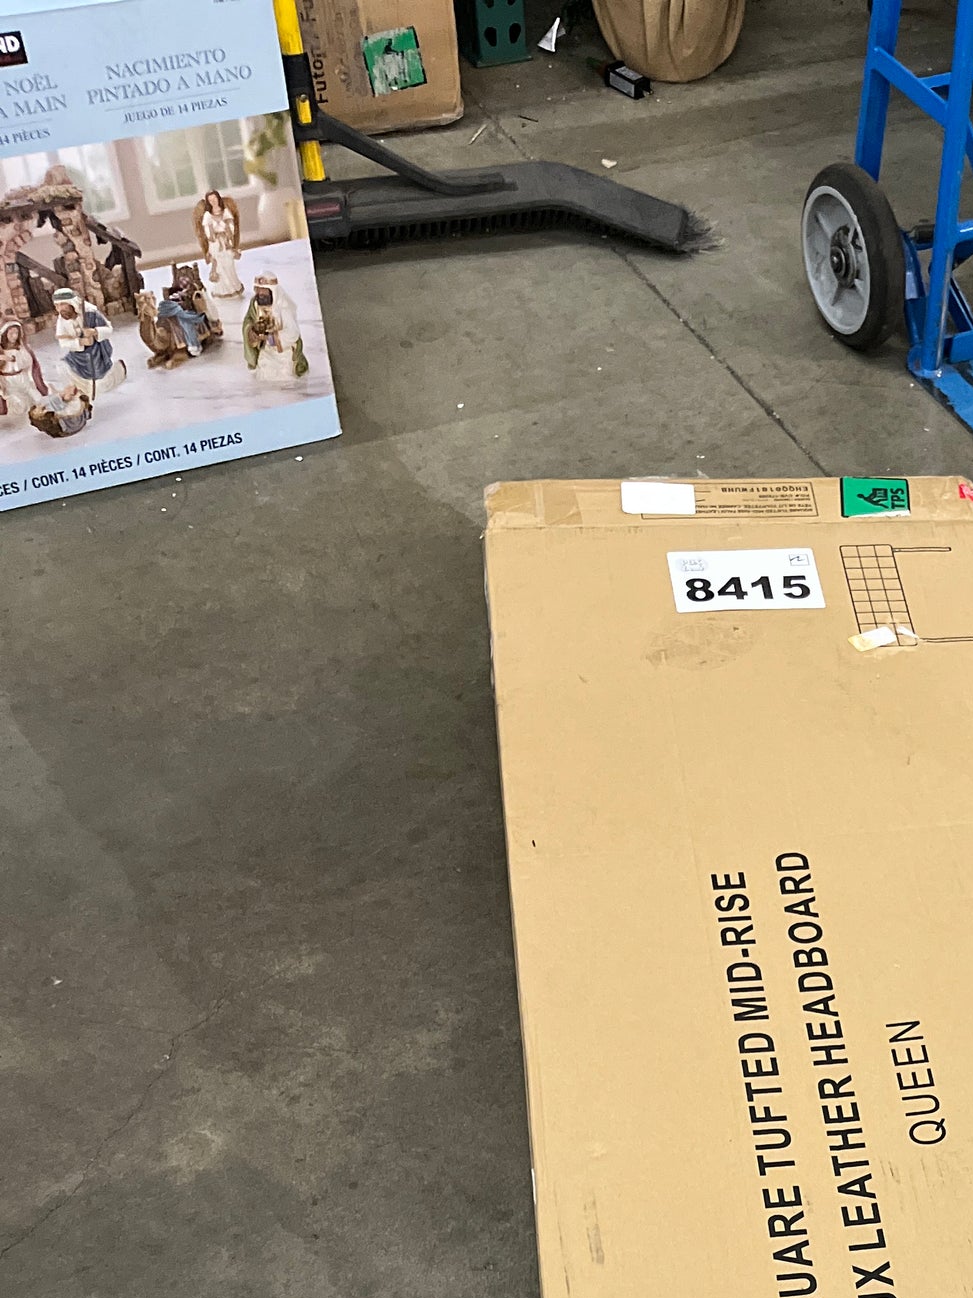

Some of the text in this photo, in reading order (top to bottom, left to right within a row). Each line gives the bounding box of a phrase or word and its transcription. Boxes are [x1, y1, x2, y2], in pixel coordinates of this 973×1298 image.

[105, 48, 226, 80] NACIMIENTO
[14, 94, 68, 116] MAIN
[86, 65, 252, 105] PINTADO A MANO
[124, 98, 228, 124] JUEGO DE 14 PIEZAS
[12, 128, 50, 143] PIÈCES
[32, 471, 69, 489] CONT.
[72, 467, 87, 482] 14
[89, 456, 133, 476] PIÈCES
[144, 447, 180, 464] CONT.
[183, 442, 198, 458] 14
[200, 432, 243, 452] PIEZAS
[890, 488, 905, 509] TPS
[686, 575, 811, 602] 8415
[711, 871, 770, 1021] MID-RISE
[775, 852, 849, 1067] HEADBOARD
[886, 1020, 946, 1145] QUEEN
[739, 1033, 796, 1176] TUFTED
[819, 1074, 886, 1251] LEATHER
